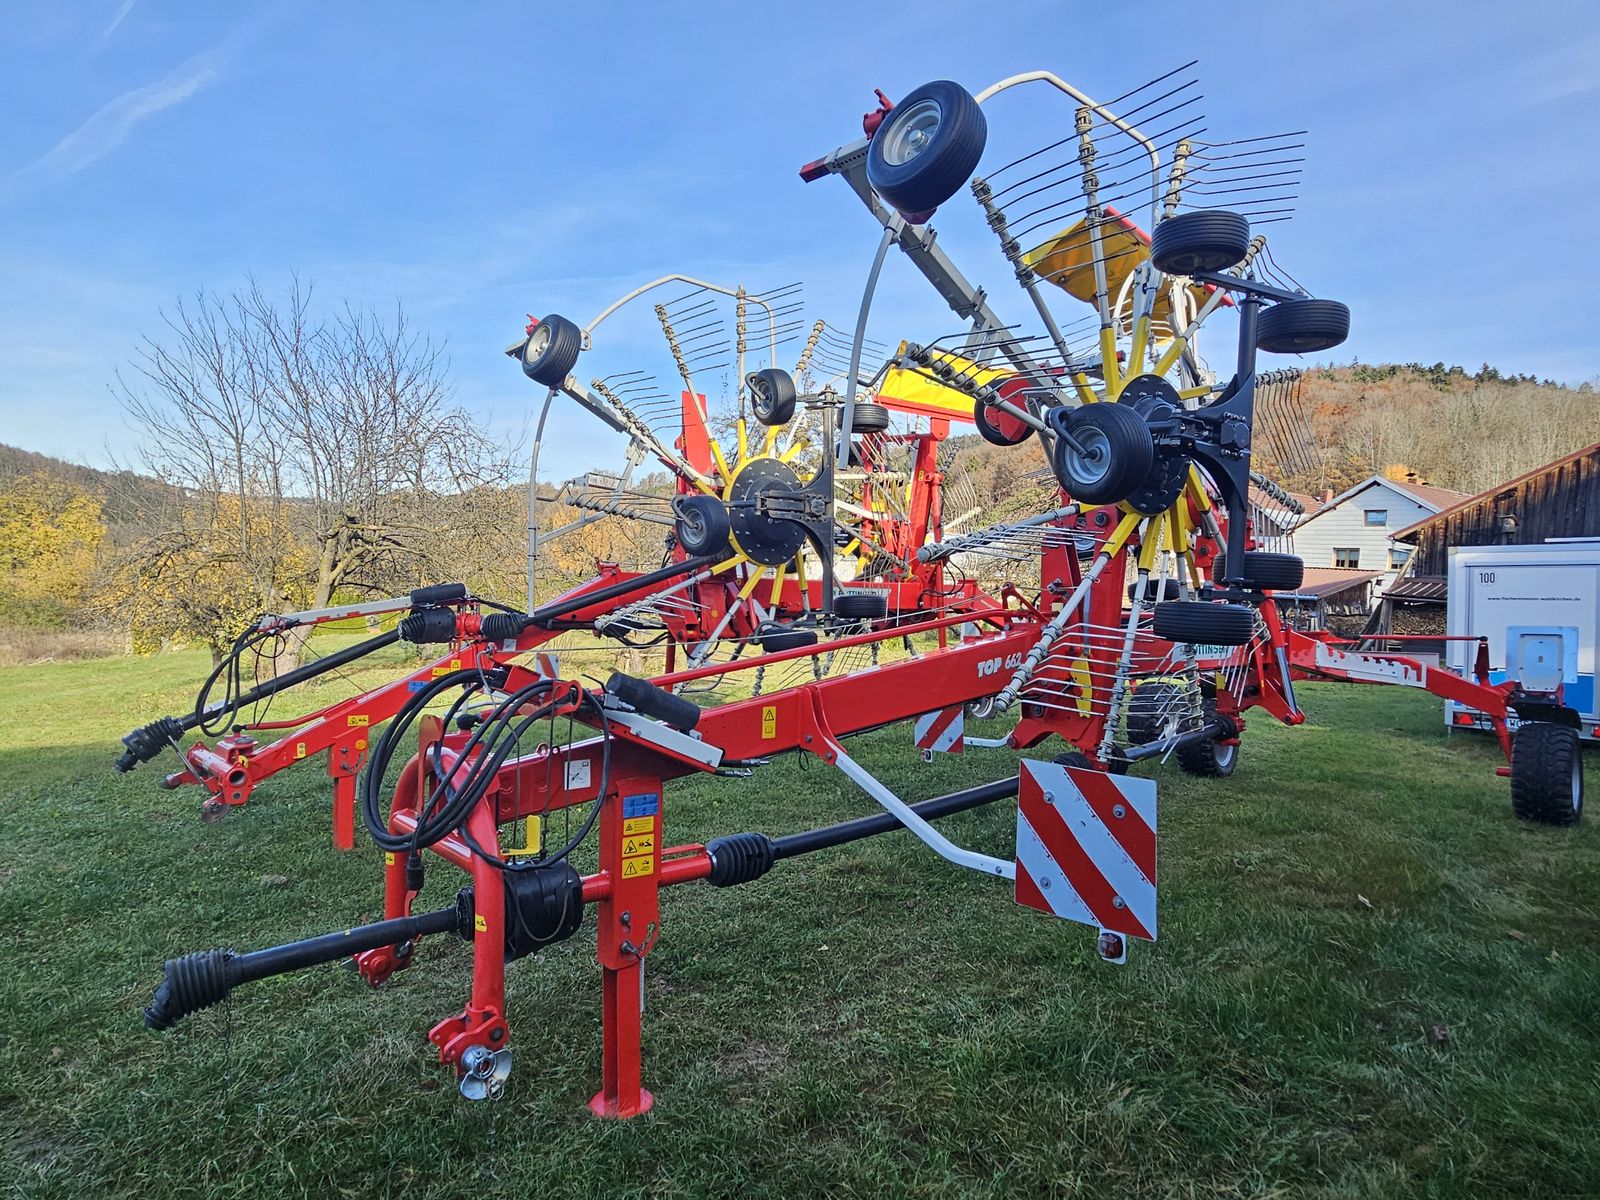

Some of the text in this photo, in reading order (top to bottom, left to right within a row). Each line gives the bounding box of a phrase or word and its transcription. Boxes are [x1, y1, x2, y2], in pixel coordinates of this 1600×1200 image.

[1479, 572, 1496, 584] 100
[977, 652, 1022, 678] TOP 662
